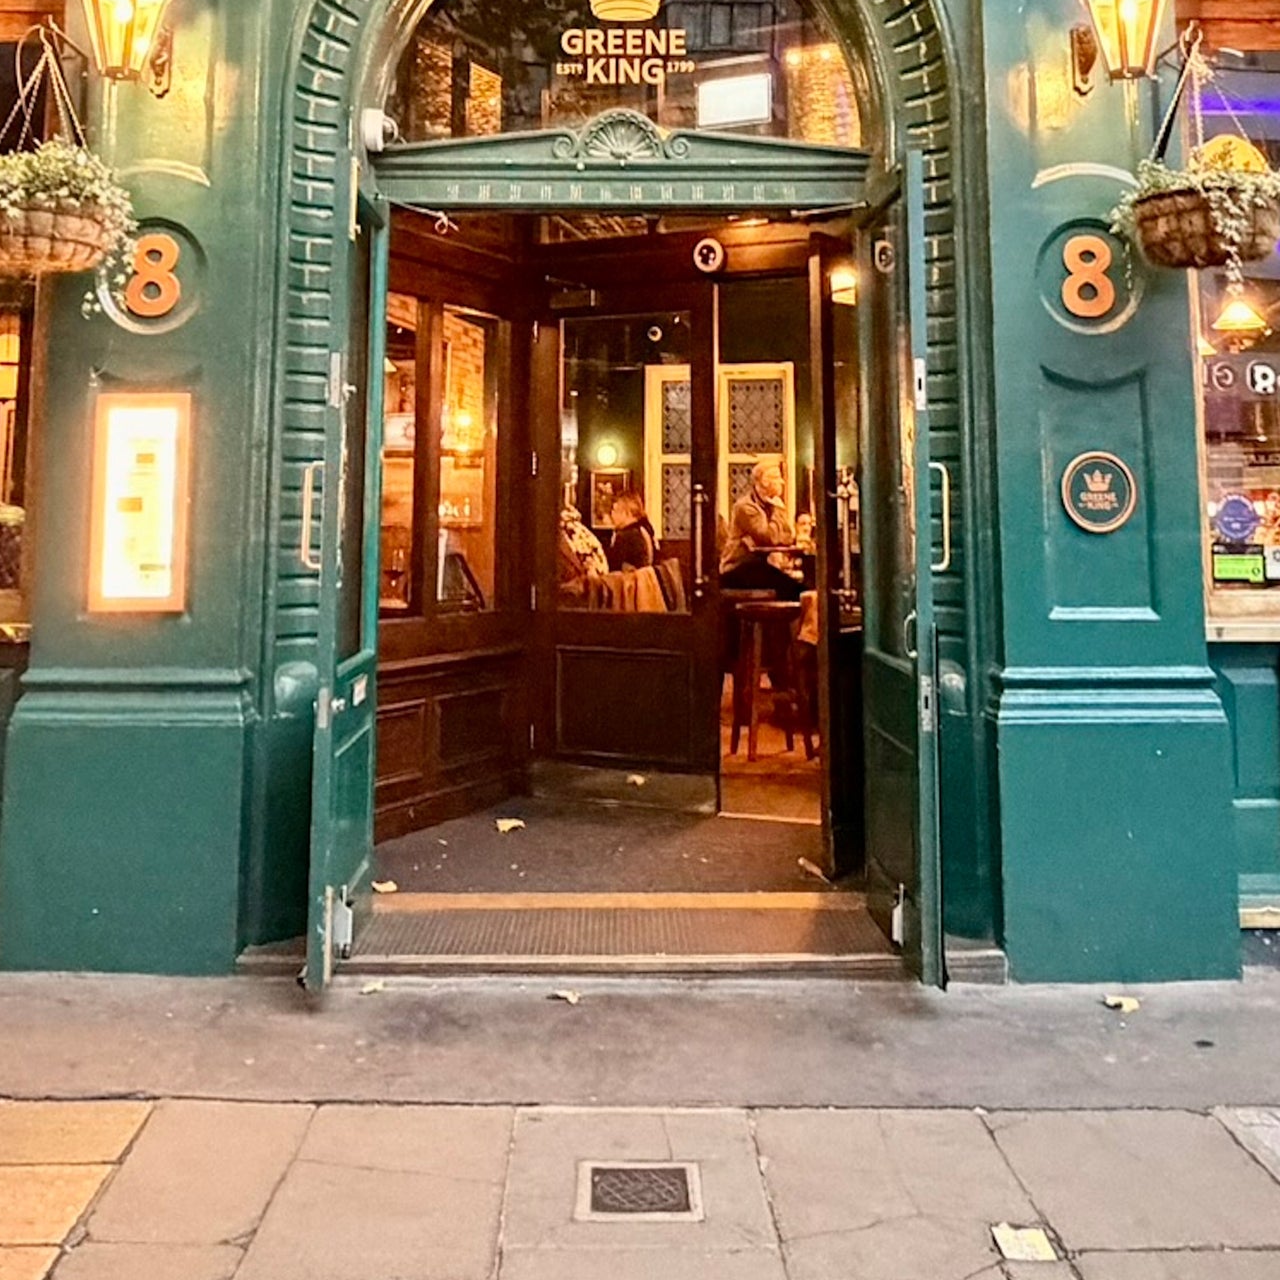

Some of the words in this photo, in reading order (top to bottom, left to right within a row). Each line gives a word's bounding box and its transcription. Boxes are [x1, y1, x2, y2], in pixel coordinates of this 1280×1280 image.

[561, 28, 687, 56] GREENE
[586, 58, 665, 85] KING
[666, 61, 695, 73] 1799
[126, 233, 180, 317] 8
[1061, 234, 1115, 318] 8
